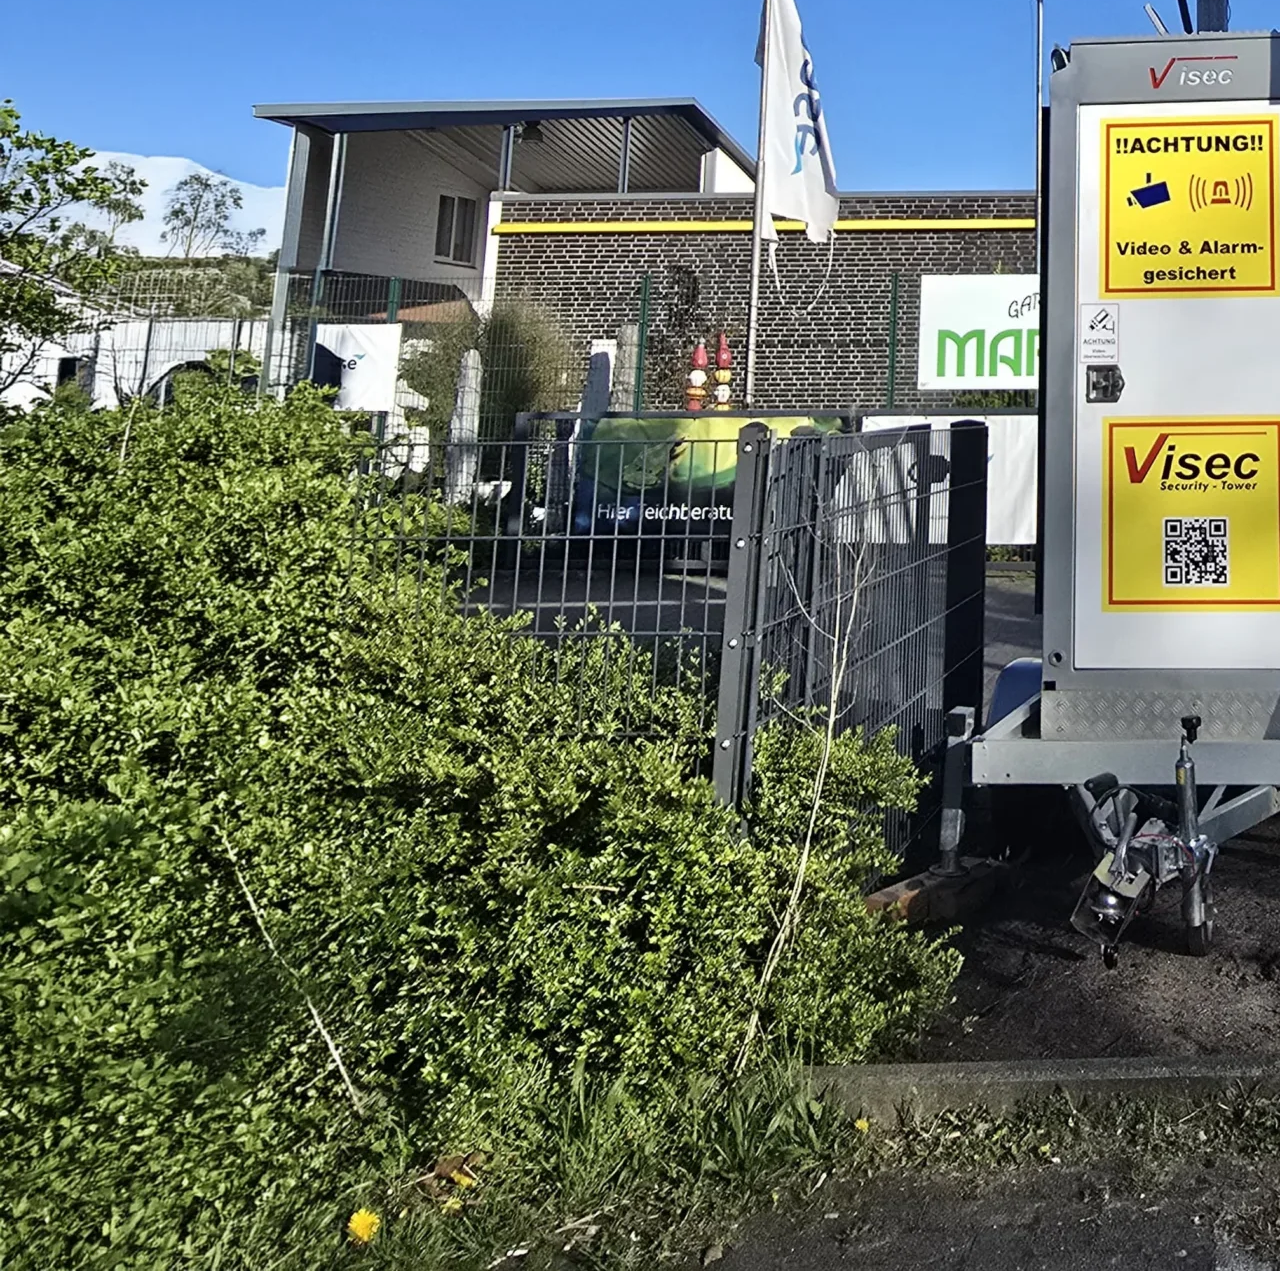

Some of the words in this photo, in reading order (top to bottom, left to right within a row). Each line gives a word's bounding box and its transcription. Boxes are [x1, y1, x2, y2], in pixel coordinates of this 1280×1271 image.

[1149, 56, 1234, 89] Visec
[1116, 135, 1263, 154] !!ACHTUNG!!
[1116, 241, 1171, 256] Video
[1178, 240, 1192, 255] &
[1200, 240, 1264, 255] Alarm-
[1143, 265, 1236, 284] gesichert
[1124, 432, 1260, 483] Visec
[1160, 480, 1209, 493] Security
[1221, 480, 1258, 491] Tower
[597, 503, 634, 520] Hier
